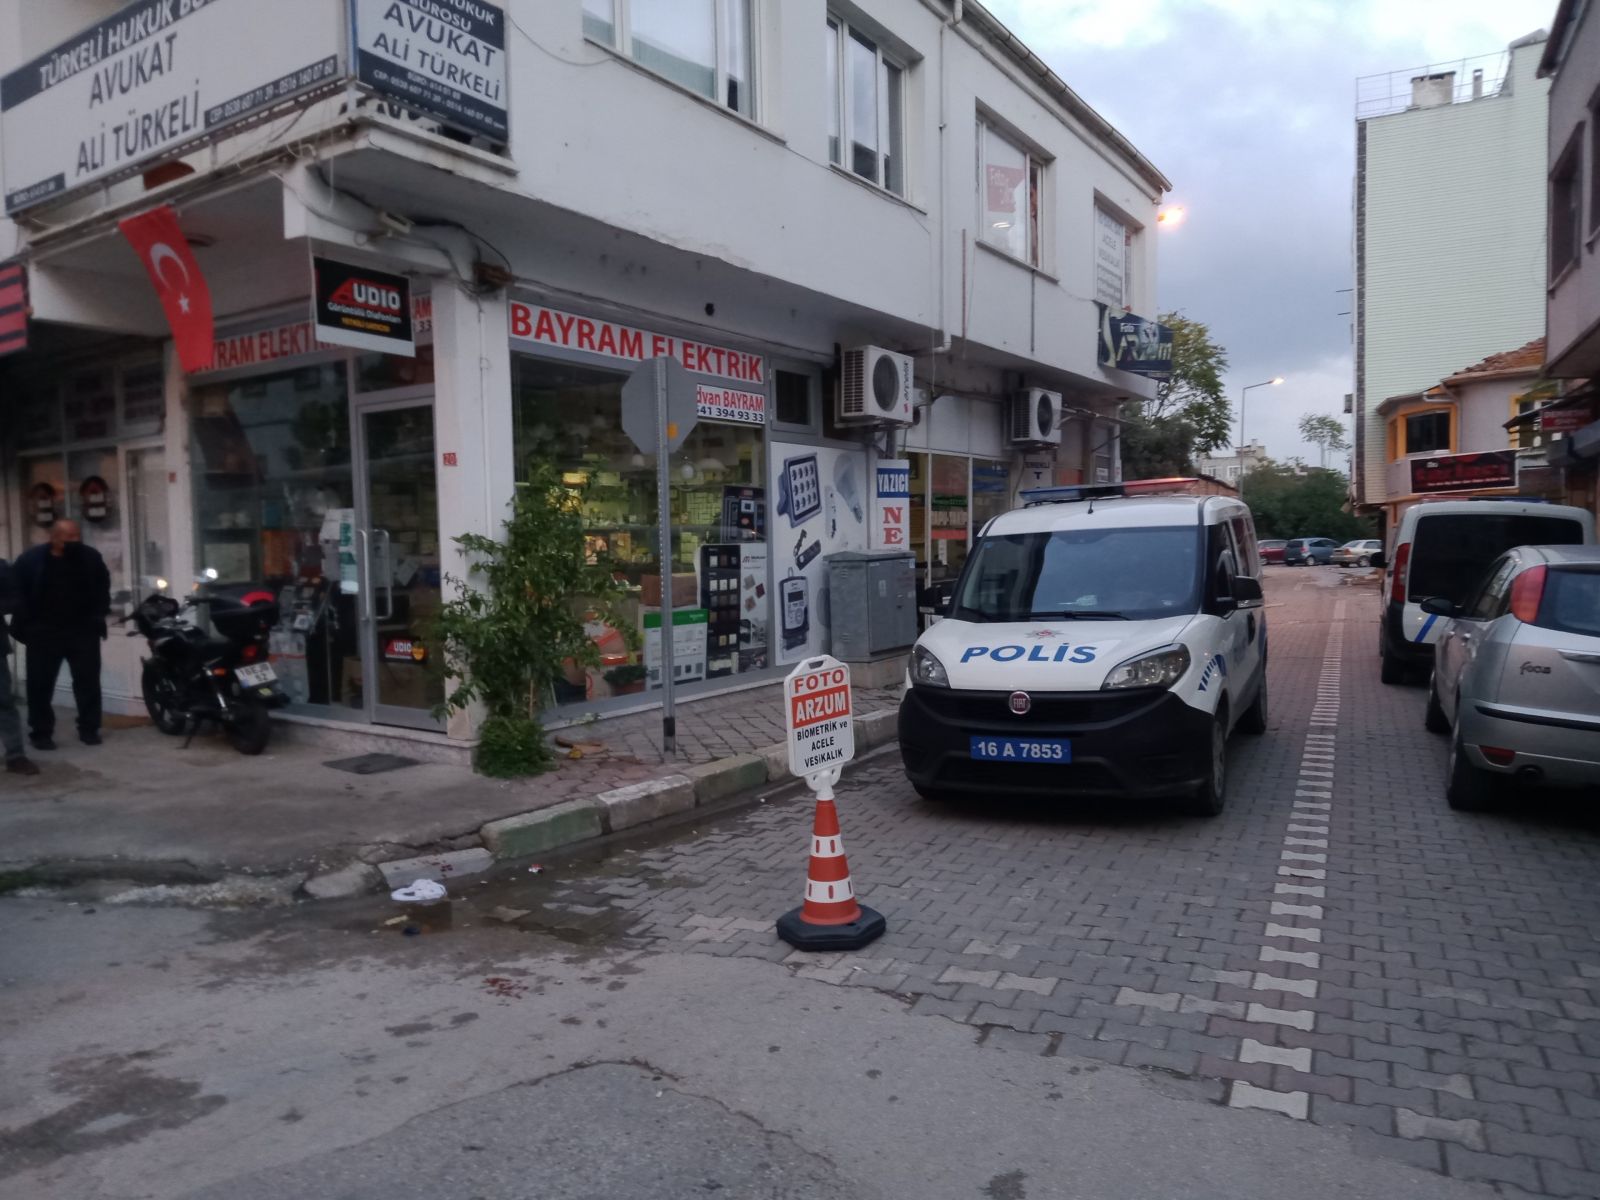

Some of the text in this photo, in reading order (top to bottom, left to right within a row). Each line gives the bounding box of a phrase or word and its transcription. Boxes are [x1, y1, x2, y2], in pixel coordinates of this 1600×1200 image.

[450, 0, 496, 26] UKUK
[40, 27, 103, 90] TÜRKELİ
[108, 0, 173, 54] HUKUK
[384, 2, 496, 67] AVUKAT
[89, 32, 177, 109] AVUKAT
[373, 32, 500, 101] ALİ TÜRKELİ
[76, 79, 199, 177] ALİ TÜRKELİ
[511, 303, 643, 360] BAYRAM
[213, 336, 256, 370] RAM
[697, 386, 764, 412] dvan BAYRAM
[697, 406, 764, 422] 41 394 93 33
[878, 473, 909, 492] YAZICI
[883, 507, 904, 544] NE
[959, 642, 1098, 664] POLİS
[794, 669, 844, 693] FOTO
[795, 691, 846, 723] ARZUM
[1013, 698, 1026, 709] FIAT
[840, 720, 848, 729] ve
[811, 736, 835, 751] ACELE
[978, 741, 1063, 759] 16 A 7853
[804, 748, 843, 768] VESİKALIK
